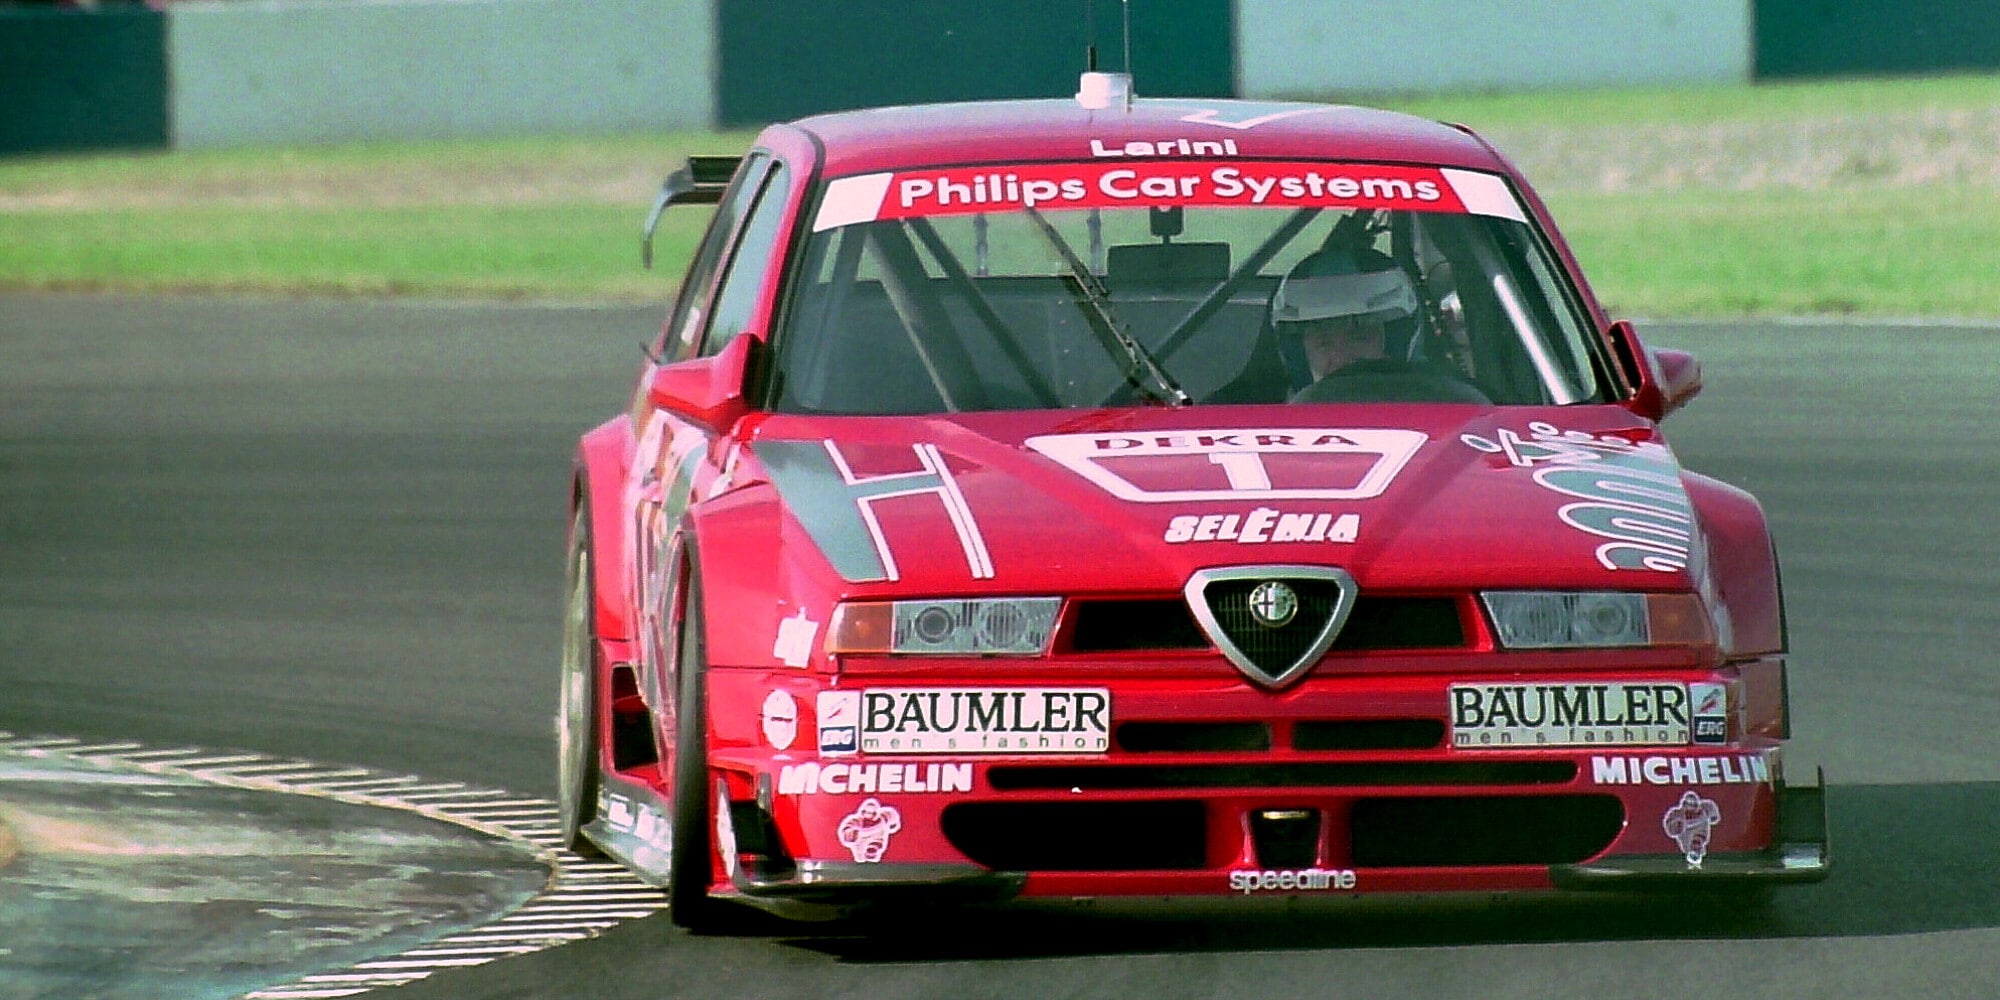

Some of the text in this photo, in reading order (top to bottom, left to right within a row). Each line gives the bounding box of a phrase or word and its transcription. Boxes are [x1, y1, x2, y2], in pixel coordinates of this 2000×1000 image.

[1090, 138, 1238, 156] Larini
[900, 165, 1441, 208] Philips Car Systems
[1094, 434, 1360, 449] DEKRA
[1209, 451, 1271, 490] 1
[864, 691, 1107, 733] BÄUMLER
[1453, 685, 1688, 728] BÄUMLER
[982, 734, 1107, 749] fashion
[1568, 727, 1688, 743] fashion
[778, 763, 973, 795] MICHELIN
[1592, 756, 1769, 785] MICHELIN
